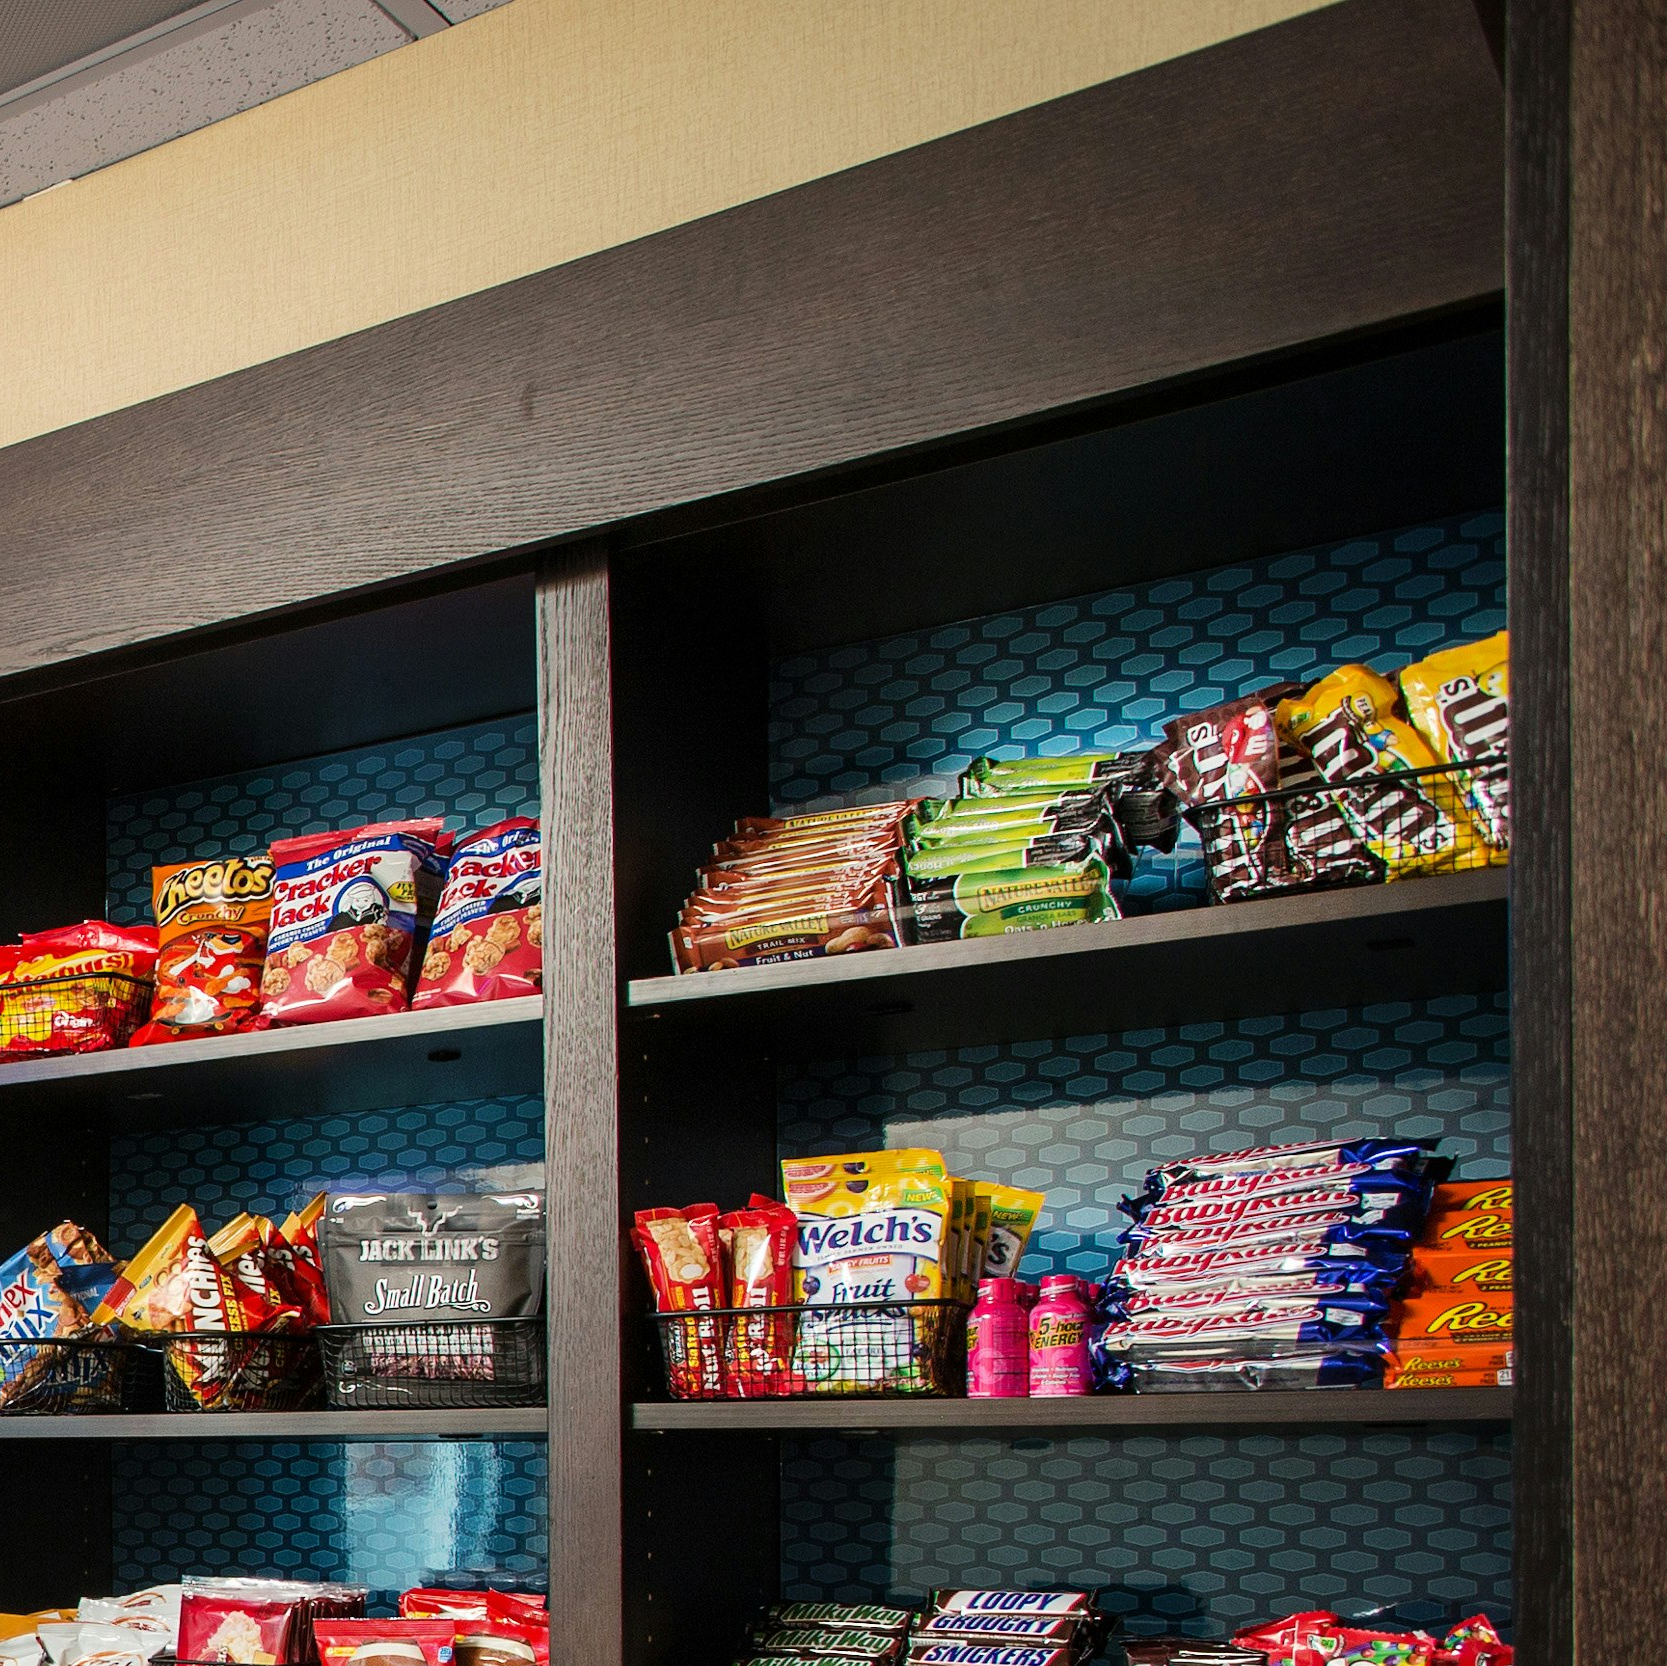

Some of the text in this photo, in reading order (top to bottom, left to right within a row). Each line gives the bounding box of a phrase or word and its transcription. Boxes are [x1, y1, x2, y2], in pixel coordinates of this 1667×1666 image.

[306, 836, 392, 872] The Original
[273, 854, 383, 902] Cracker
[176, 906, 244, 925] Crunchy
[271, 895, 332, 930] Jack
[1017, 901, 1073, 914] CRUNCHY
[728, 916, 827, 946] NATURE VALLEY
[757, 936, 806, 950] TRAIL MIX
[755, 949, 814, 966] Fruit Nut
[799, 1215, 934, 1257] Welch's
[360, 1236, 500, 1263] JACK LINK'S
[365, 1268, 493, 1315] Small Batch
[1041, 1318, 1085, 1336] 5-hour
[1035, 1332, 1085, 1350] ENERGY
[1403, 1356, 1461, 1371] Reese's
[1395, 1373, 1455, 1387] Reese's
[967, 1591, 1064, 1610] LOOPY
[933, 1615, 1059, 1635] GROUCHY
